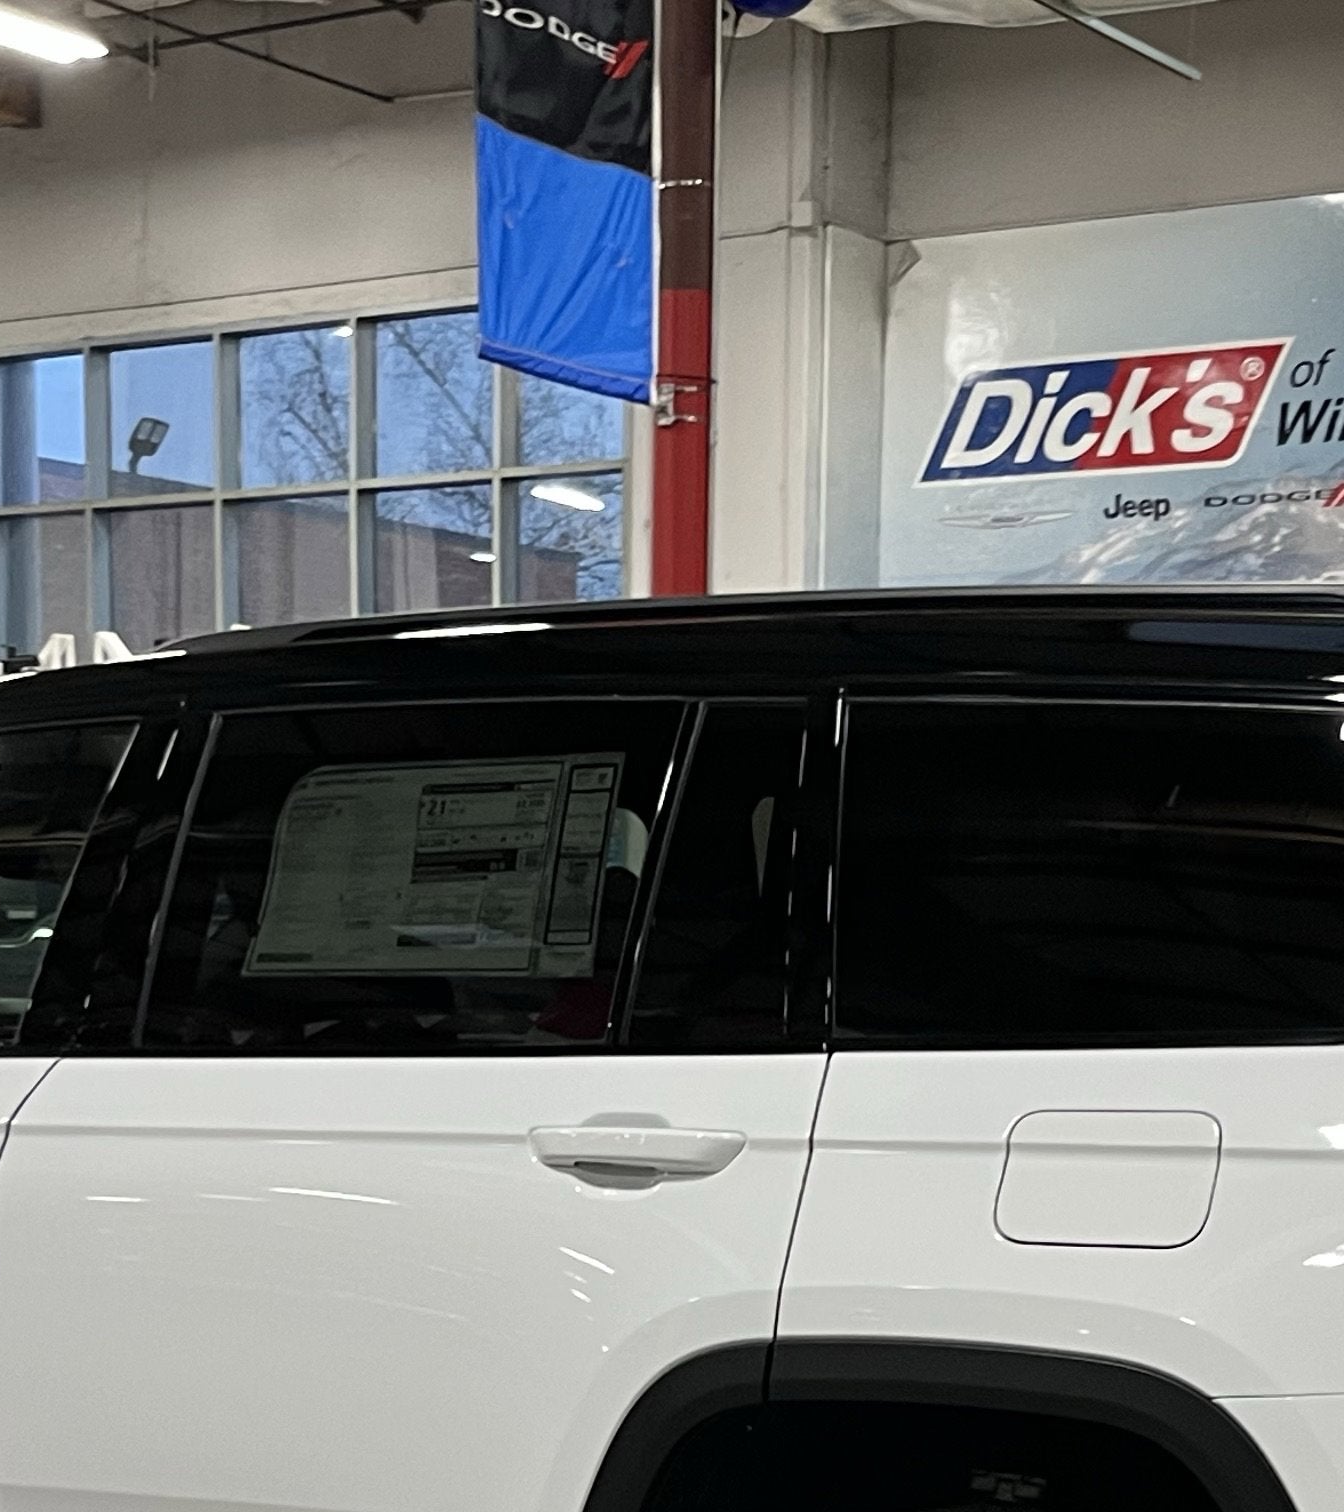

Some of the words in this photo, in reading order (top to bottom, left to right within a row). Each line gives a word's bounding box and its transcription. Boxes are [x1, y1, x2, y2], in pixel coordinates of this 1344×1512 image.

[1290, 348, 1336, 388] of
[940, 358, 1245, 469] Dick's
[1103, 493, 1170, 521] Jeep
[1204, 487, 1336, 507] DODGE
